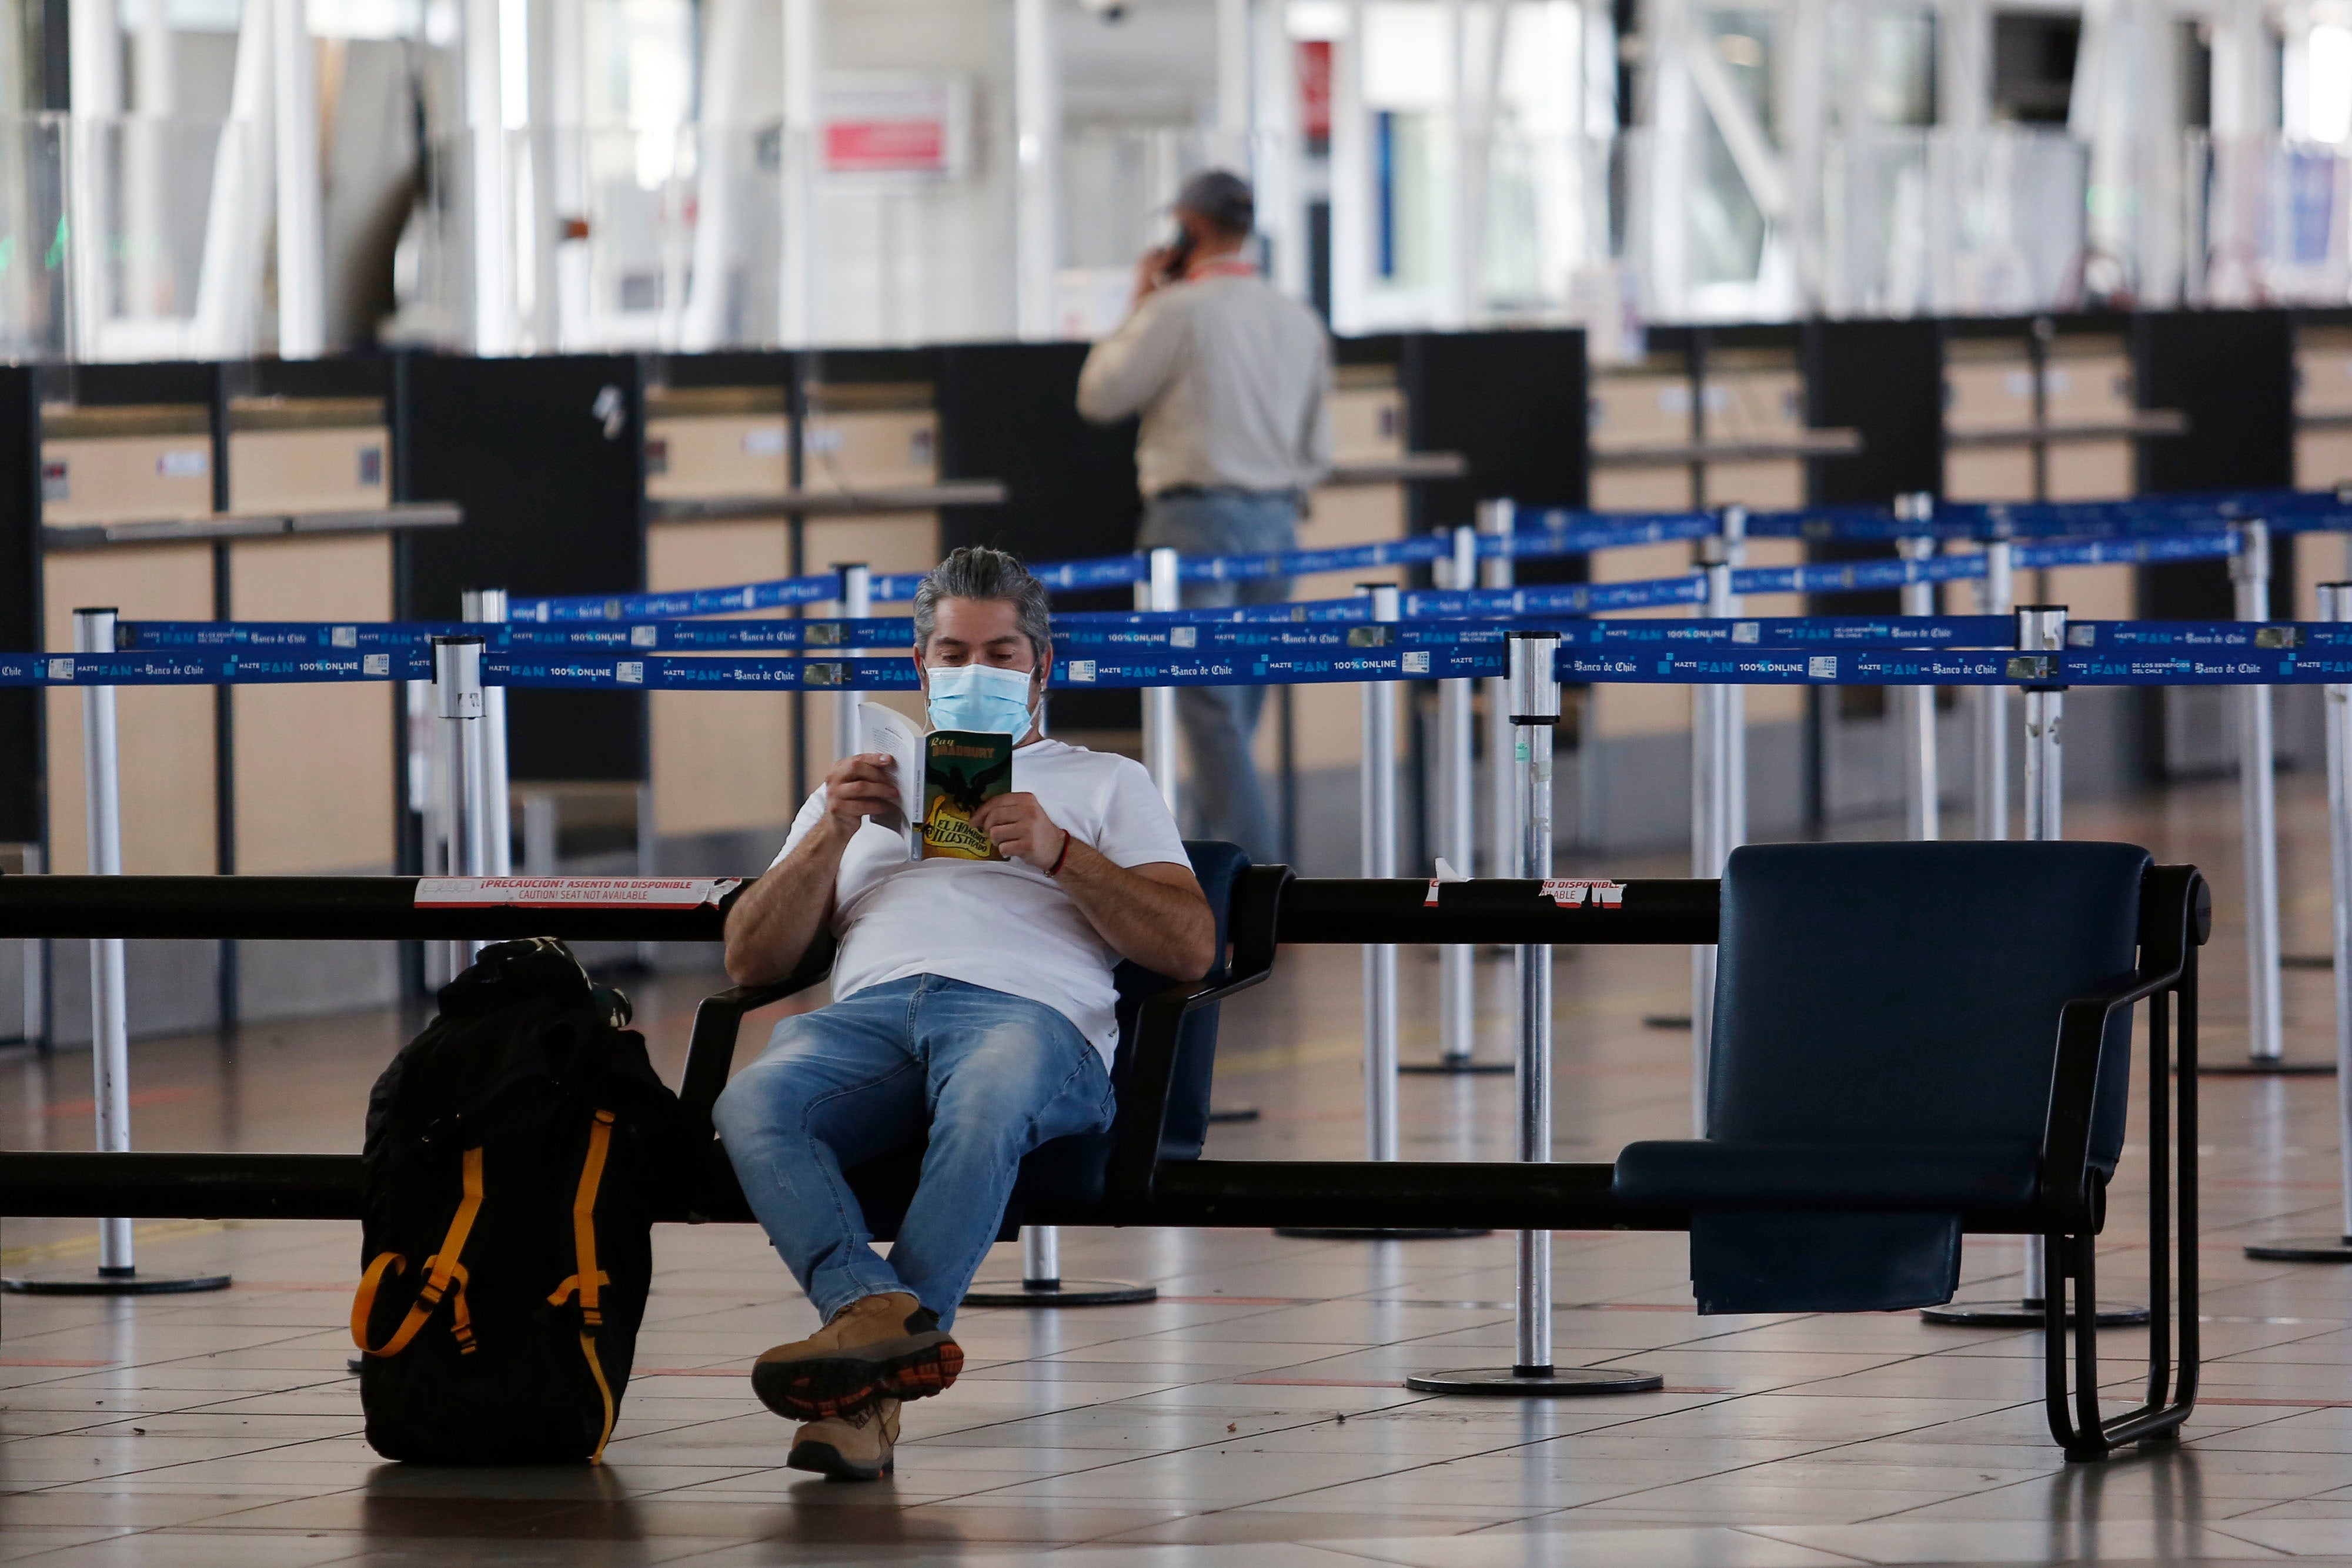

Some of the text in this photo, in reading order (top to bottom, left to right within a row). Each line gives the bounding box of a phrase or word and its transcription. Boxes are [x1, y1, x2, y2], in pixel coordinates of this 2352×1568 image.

[595, 633, 626, 641] ONLINE
[1282, 633, 1305, 644] Banco
[1319, 634, 1339, 644] Chile
[1693, 630, 1726, 638] ONLINE
[99, 666, 131, 676] FAN
[146, 664, 171, 675] Banco
[173, 665, 181, 674] de
[184, 664, 204, 675] Chile
[261, 663, 293, 673] FAN
[1122, 667, 1157, 677] FAN
[1171, 666, 1197, 676] Banco
[1200, 665, 1208, 675] de
[1211, 664, 1232, 675] Chile
[1294, 661, 1328, 672] FAN
[1334, 660, 1396, 670] 100% ONLINE
[1574, 661, 1601, 671] Banco
[1603, 661, 1612, 671] de
[1615, 661, 1637, 672] Chile
[1698, 661, 1733, 672] FAN
[1739, 663, 1803, 671] 100% ONLINE
[1882, 664, 1917, 674] FAN
[1933, 663, 1960, 674] Banco
[1963, 665, 1972, 674] de
[1975, 664, 1997, 674] Chile
[2091, 663, 2127, 674] FAN
[2194, 663, 2261, 674] Banco de Chile
[2, 666, 21, 676] Chile
[512, 666, 545, 676] FAN
[577, 668, 611, 676] ONLINE
[686, 670, 721, 680] FAN
[734, 669, 760, 680] Banco
[763, 670, 771, 680] de
[774, 670, 794, 681] Chile
[883, 670, 916, 680] FAN
[929, 737, 954, 747] Ray
[937, 820, 951, 831] EL
[931, 828, 987, 852] ILUSTRADO
[519, 890, 648, 900] CAUTION! SEAT NOT AVAILABLE
